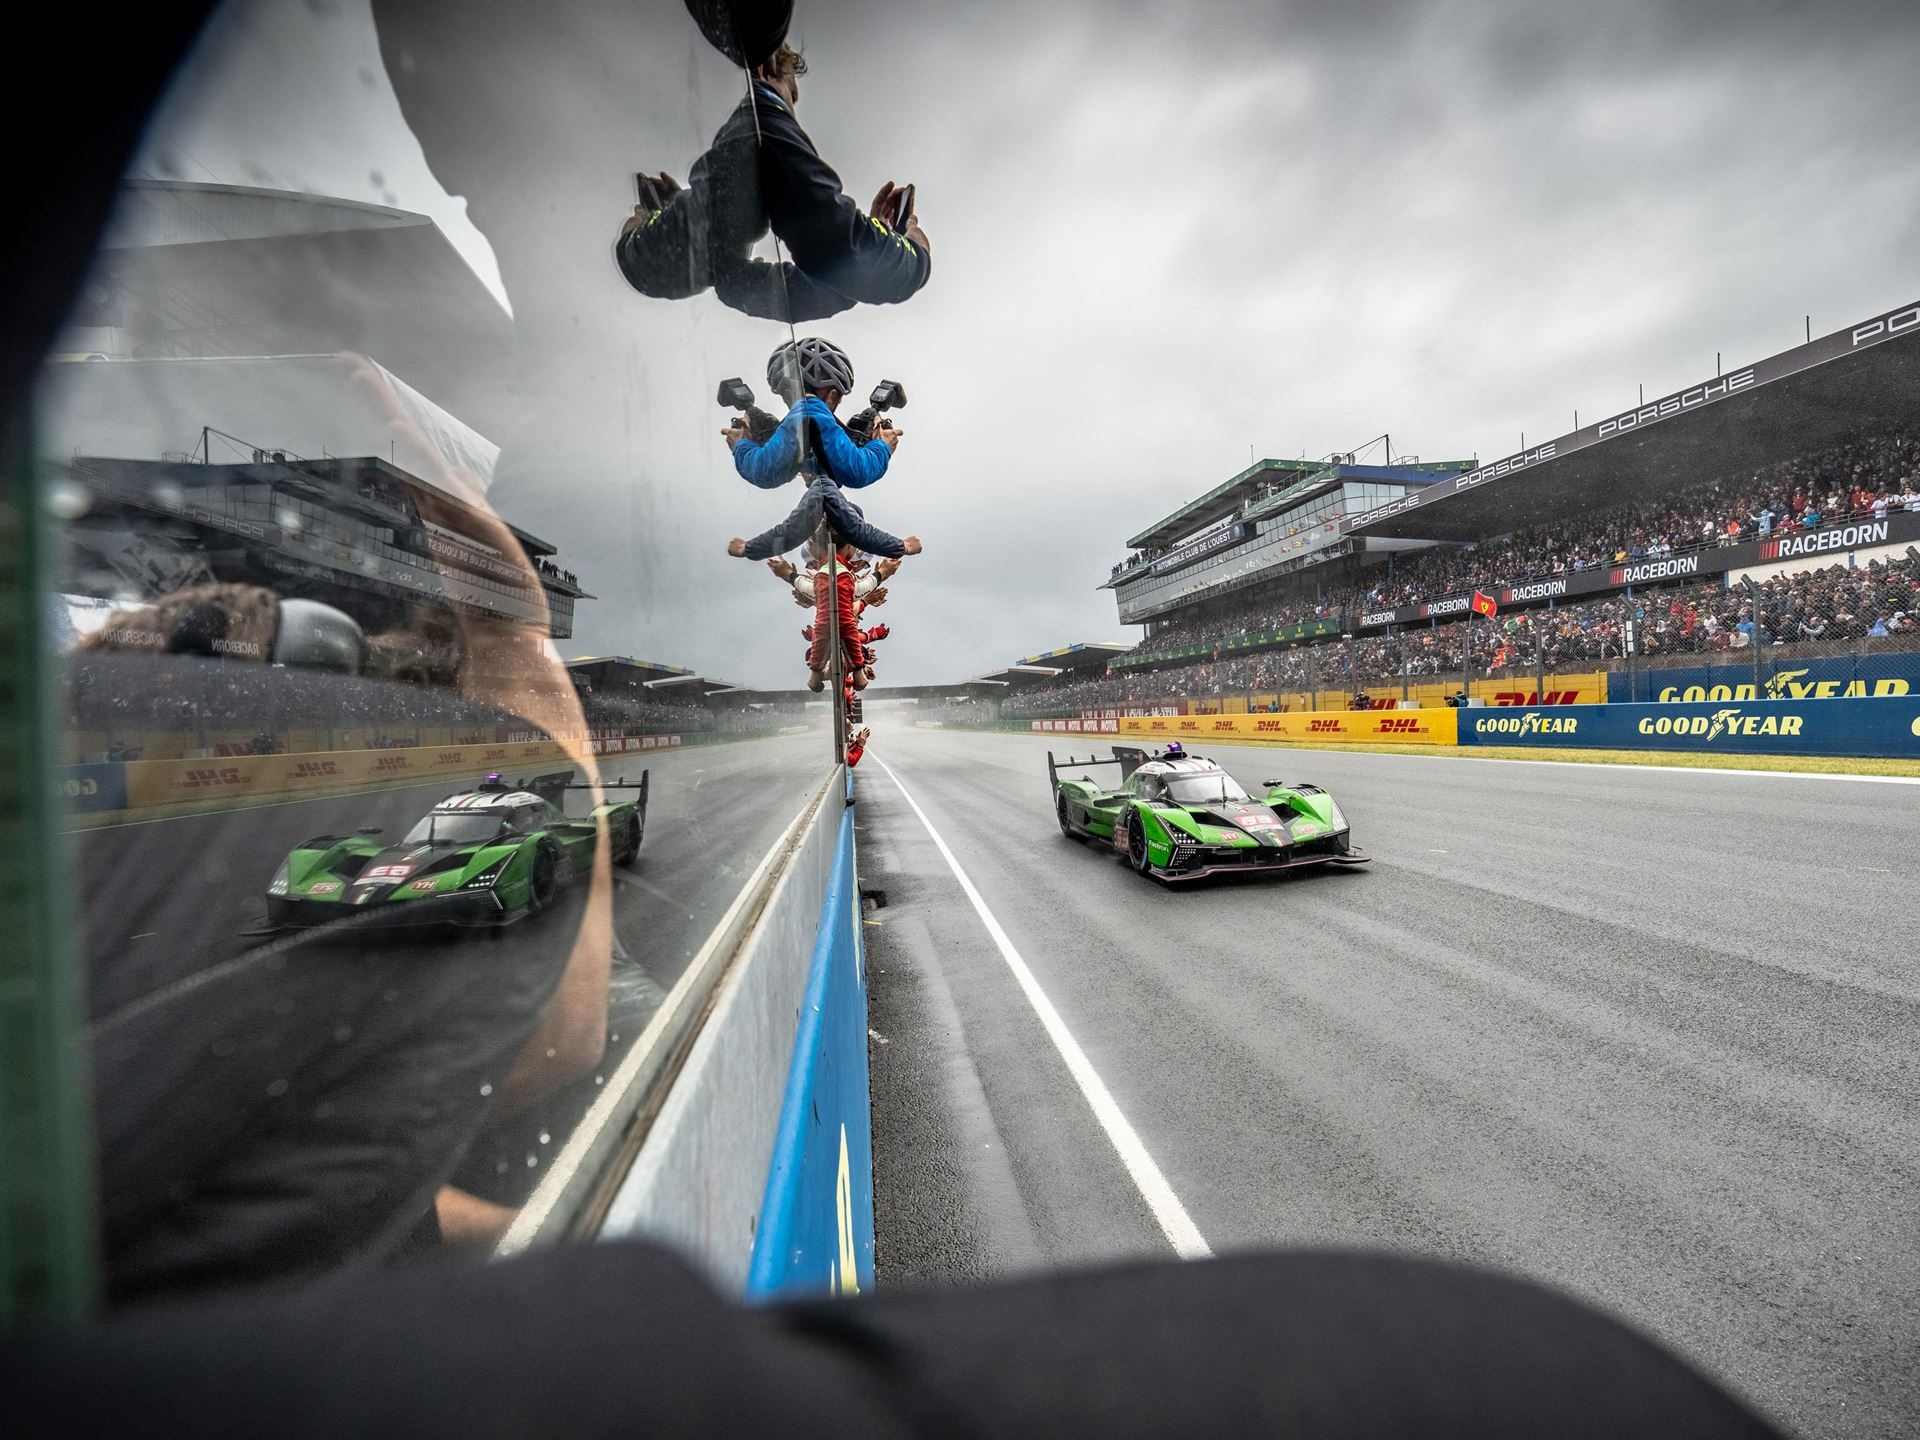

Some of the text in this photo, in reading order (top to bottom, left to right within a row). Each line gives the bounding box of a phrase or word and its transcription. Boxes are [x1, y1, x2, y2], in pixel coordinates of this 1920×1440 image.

[1598, 369, 1754, 437] PORSCHE
[1455, 444, 1556, 490] PORSCHE
[1351, 494, 1419, 528] PORSCHE
[1156, 531, 1231, 570] AUTOMOBILE CLUB DE L'OUEST
[1778, 520, 1889, 558] RACEBORN
[1622, 555, 1698, 583] RACEBORN
[1512, 579, 1566, 602] RACEBORN
[1362, 611, 1395, 625] RACEBORN
[1427, 597, 1470, 616] RACEBORN
[1215, 721, 1235, 731] DHL
[1257, 720, 1282, 731] DHL
[1310, 720, 1342, 732] DHL
[1379, 719, 1421, 733] DHL
